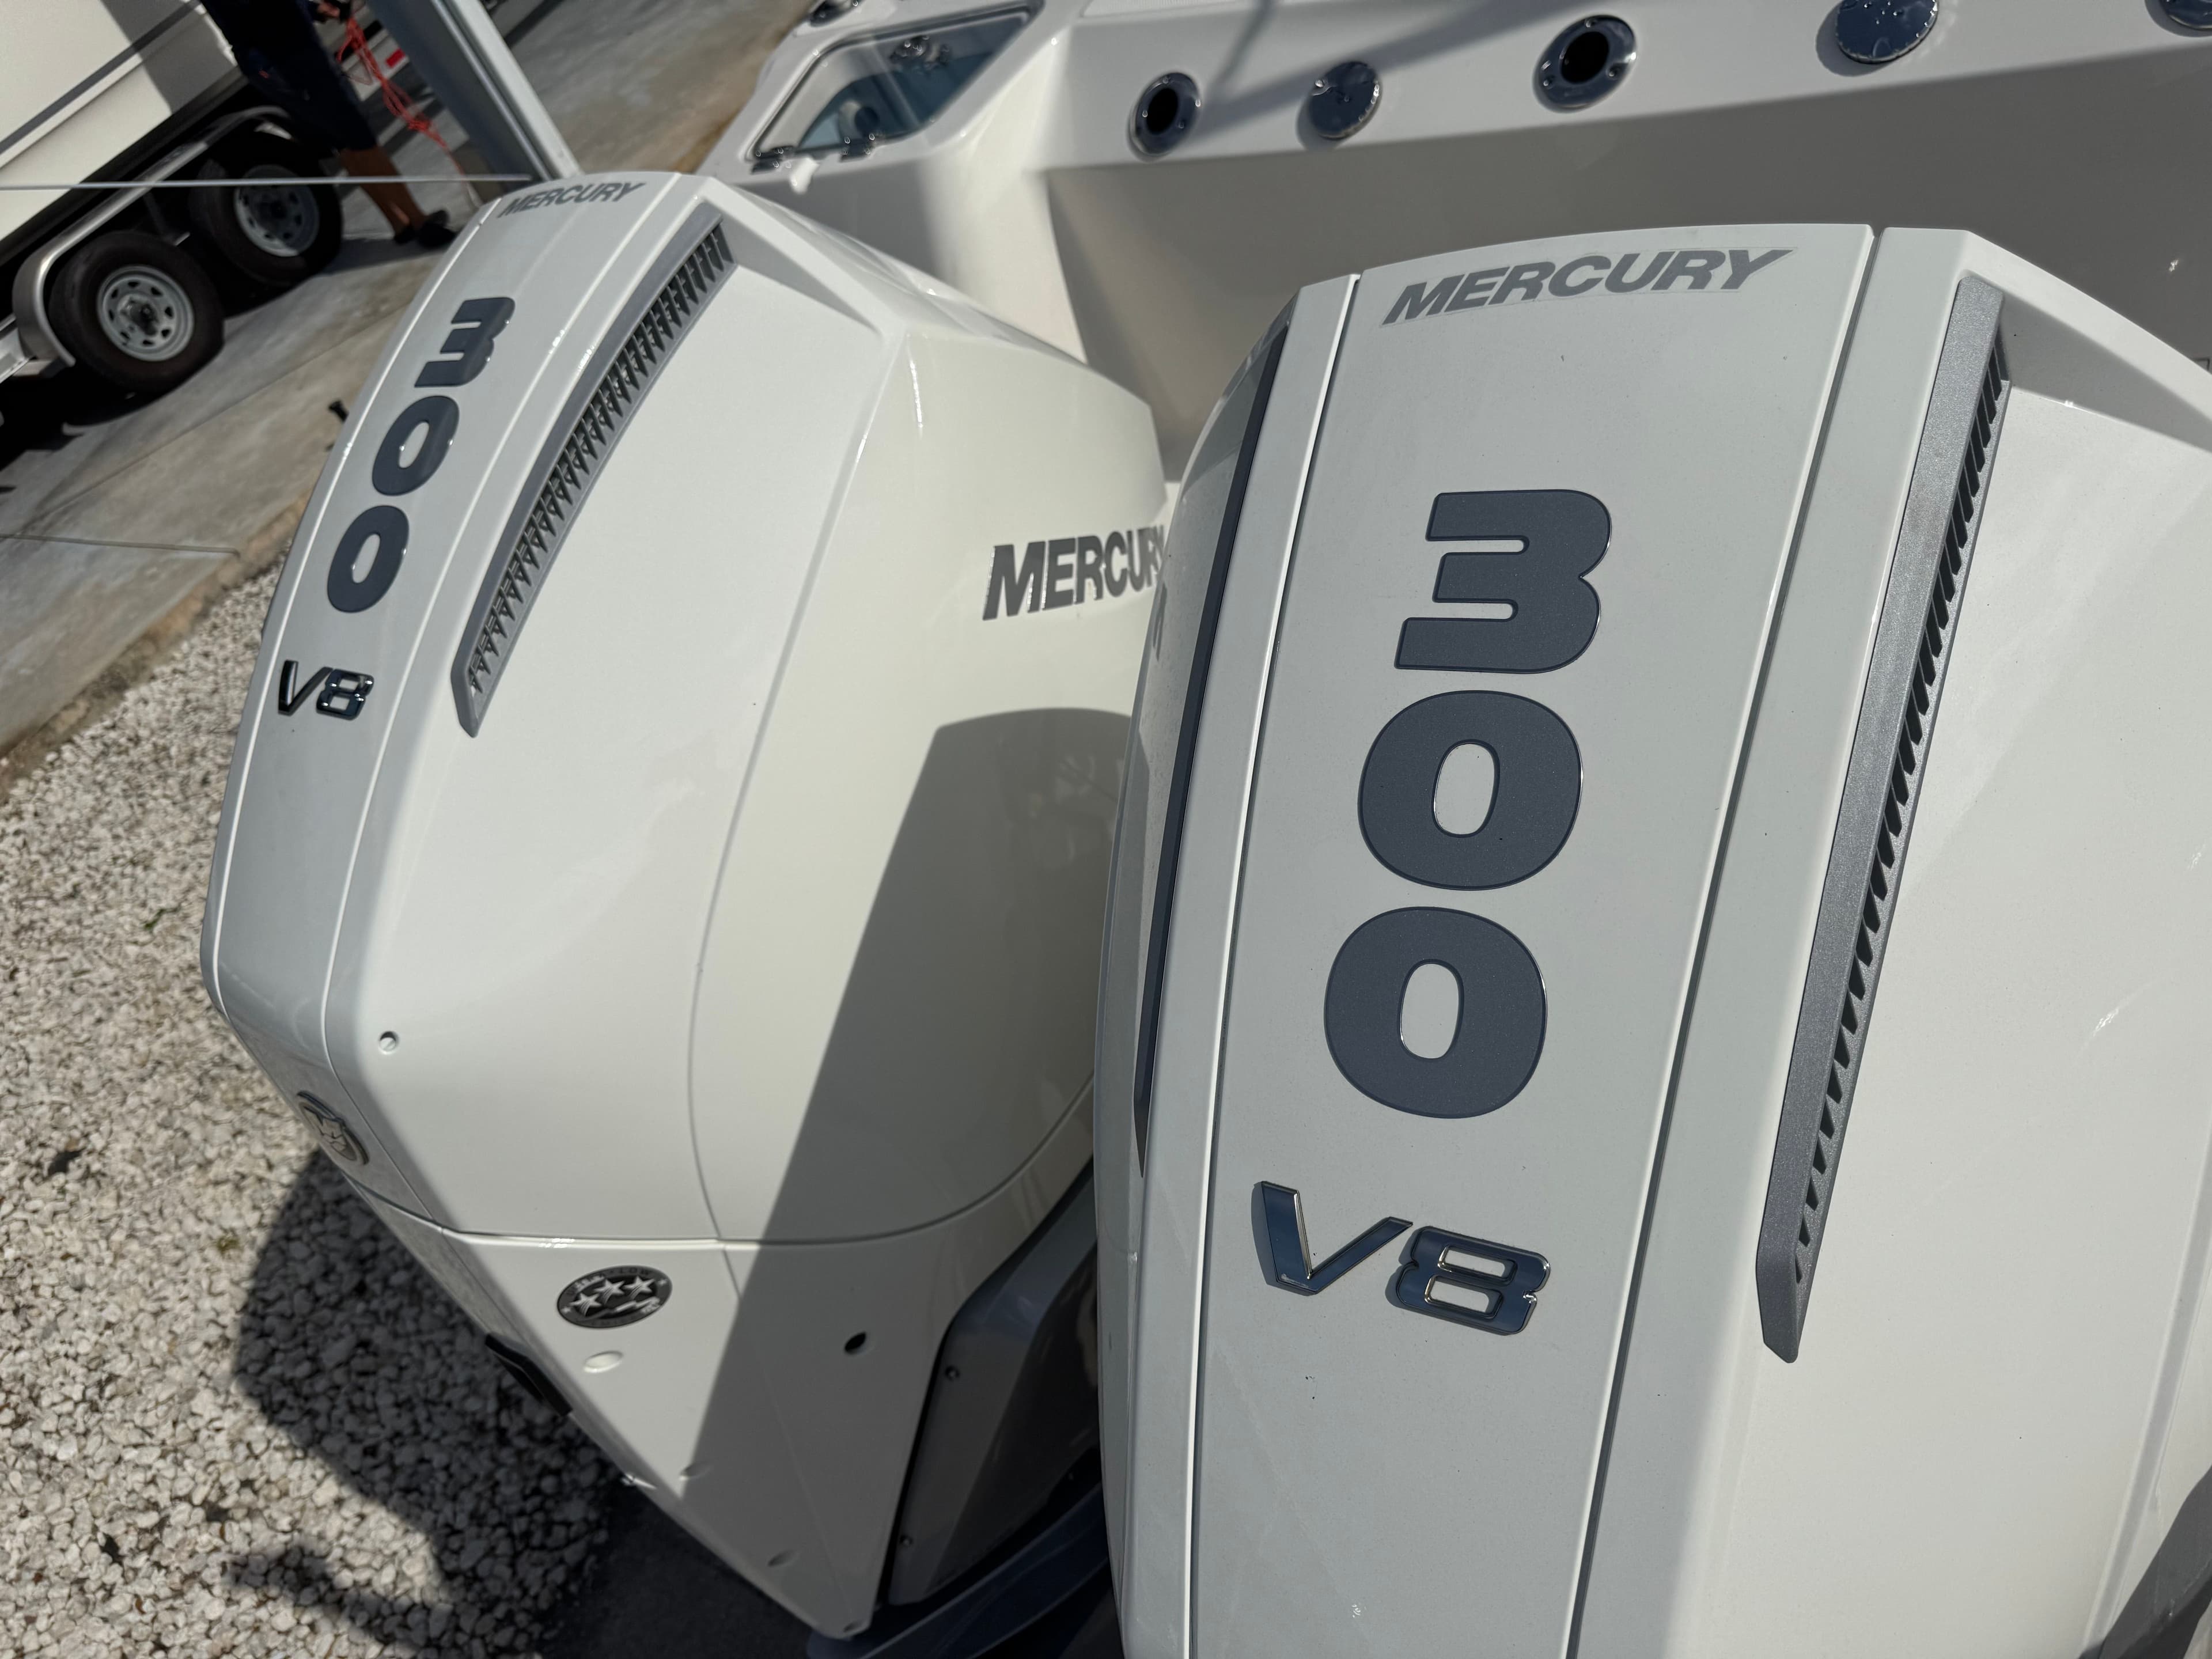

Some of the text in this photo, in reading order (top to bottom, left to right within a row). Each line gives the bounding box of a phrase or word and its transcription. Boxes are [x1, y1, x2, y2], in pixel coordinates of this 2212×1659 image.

[497, 182, 646, 218] MERCURY
[1382, 249, 1793, 325] MERCURY
[327, 297, 515, 613] 300
[278, 660, 374, 720] V8
[1324, 489, 1611, 1119] 300
[1252, 1181, 1551, 1335] V8
